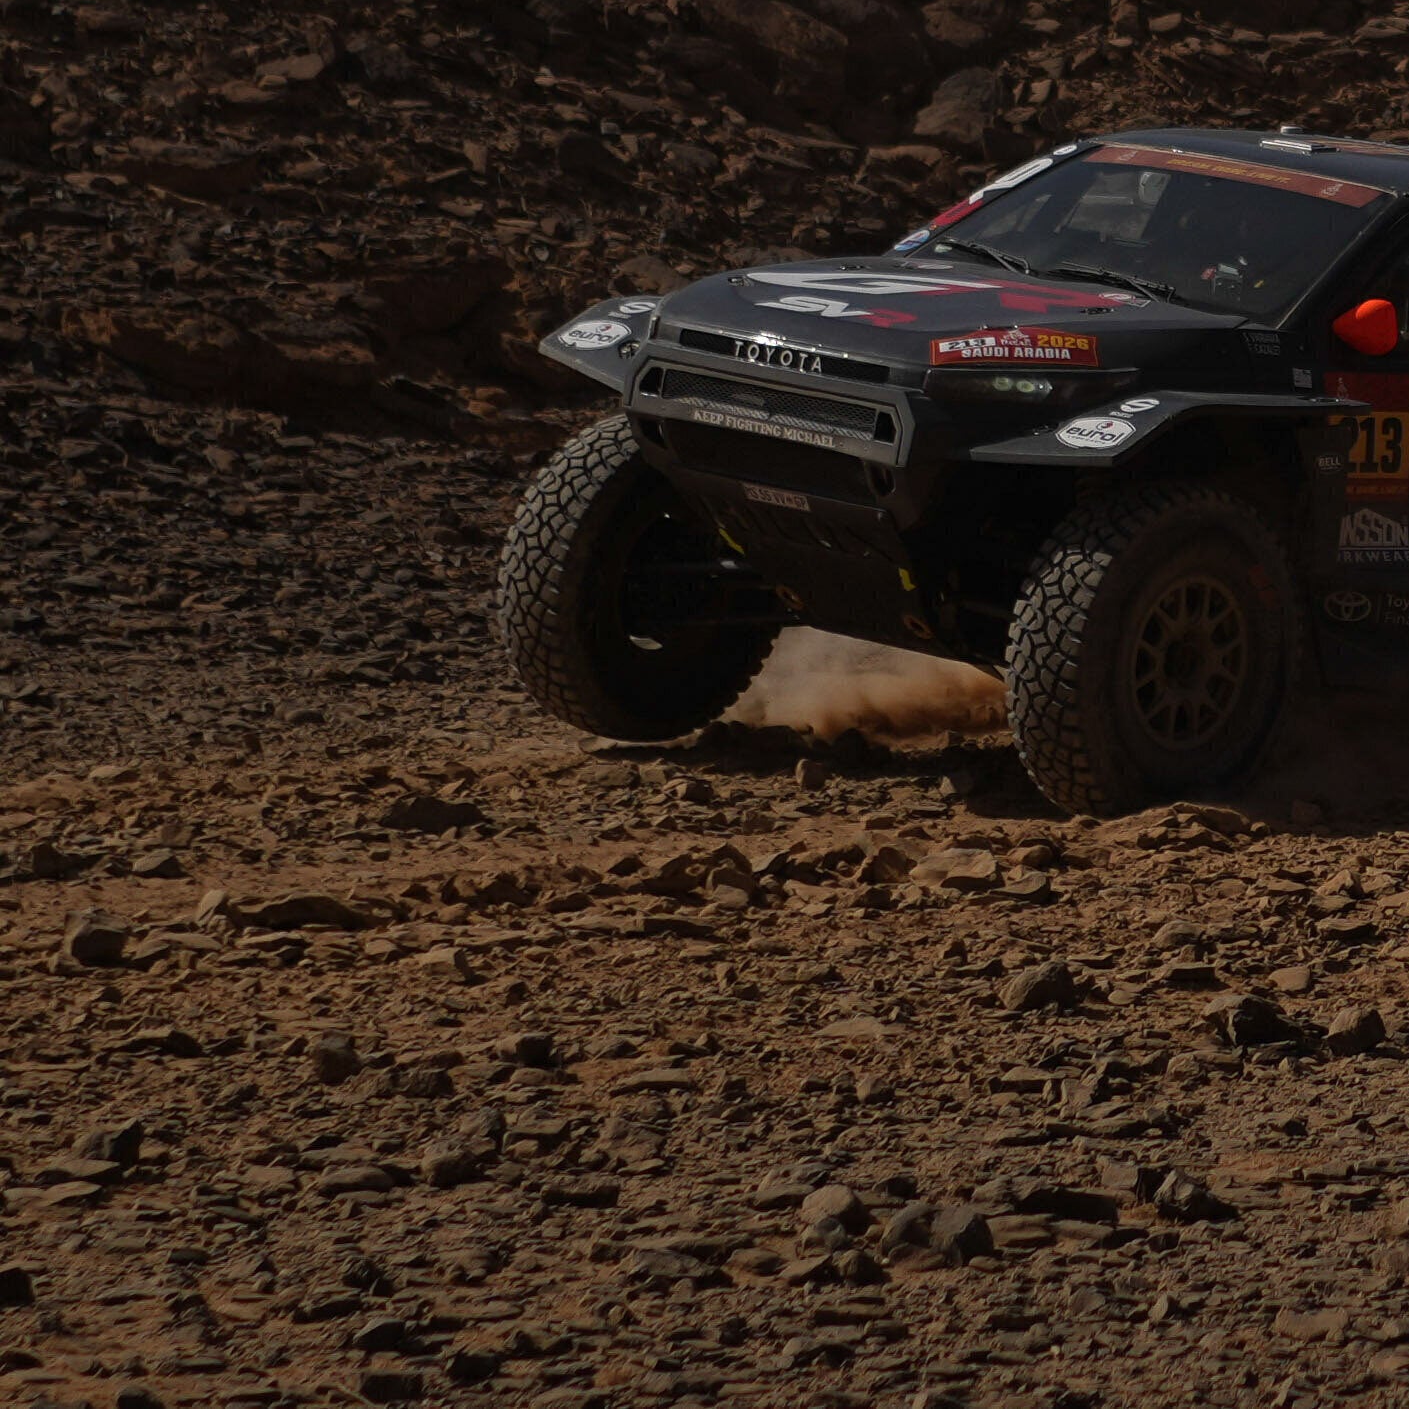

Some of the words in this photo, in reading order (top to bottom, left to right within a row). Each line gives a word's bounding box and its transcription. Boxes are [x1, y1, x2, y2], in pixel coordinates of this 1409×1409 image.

[1037, 334, 1089, 351] 2026
[732, 341, 824, 374] TOYOTA
[961, 347, 1010, 359] SAUDI
[1013, 347, 1072, 360] ARABIA
[693, 410, 724, 426] KEEP
[725, 415, 782, 437] FIGHTING
[782, 426, 836, 448] MICHAEL
[1066, 426, 1125, 443] eurol
